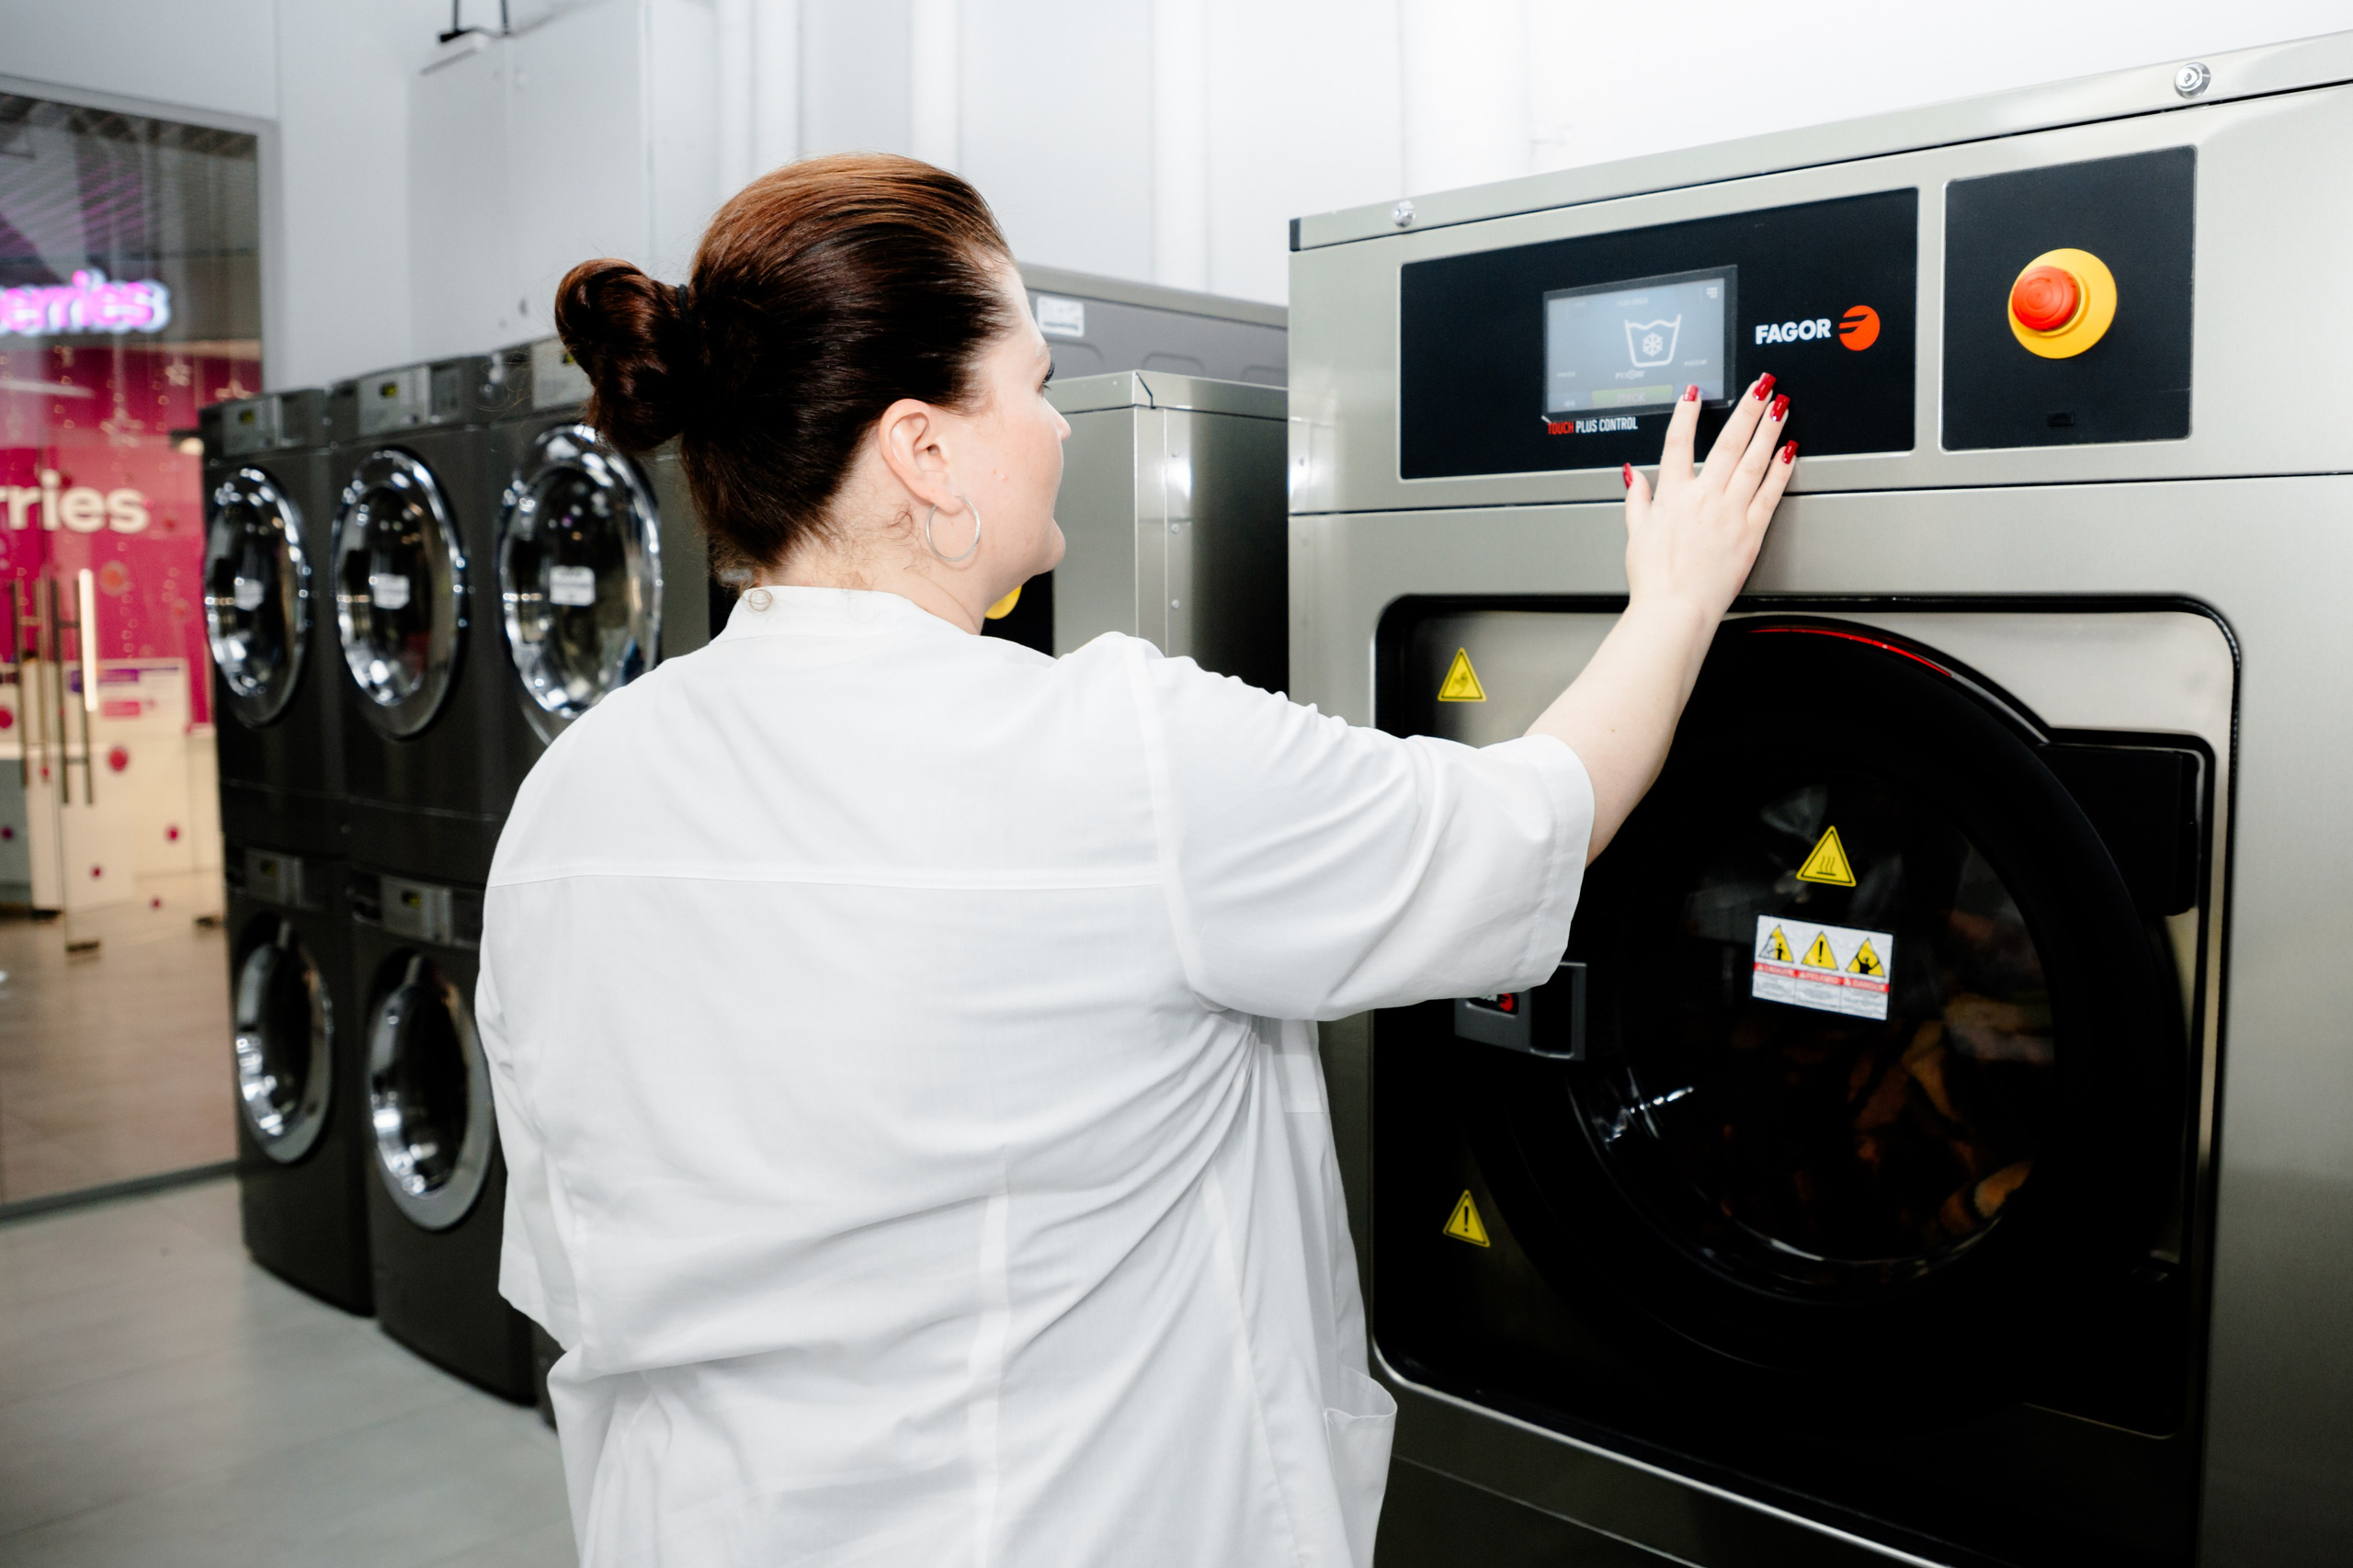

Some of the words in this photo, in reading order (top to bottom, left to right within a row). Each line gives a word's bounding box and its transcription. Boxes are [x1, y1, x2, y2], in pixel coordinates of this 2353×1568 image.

[1755, 318, 1832, 345] FAGOR
[1547, 421, 1574, 436] TOUCH
[1575, 419, 1598, 434] PLUS
[1598, 416, 1639, 432] CONTROL
